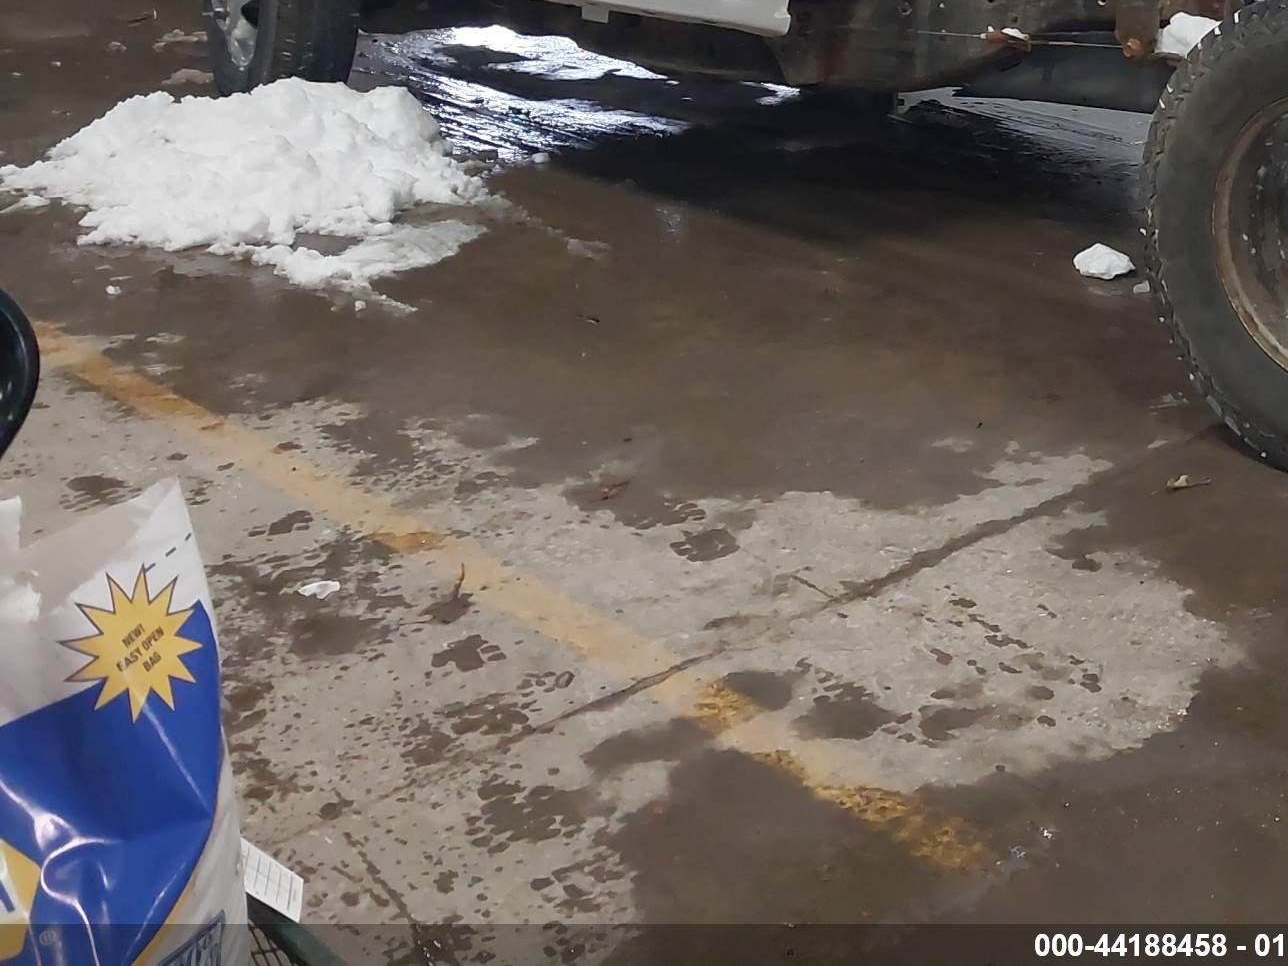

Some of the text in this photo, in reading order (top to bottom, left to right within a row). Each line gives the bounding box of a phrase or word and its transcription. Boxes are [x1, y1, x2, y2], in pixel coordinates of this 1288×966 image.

[116, 625, 165, 672] EASY OPEN
[142, 651, 162, 673] BAG
